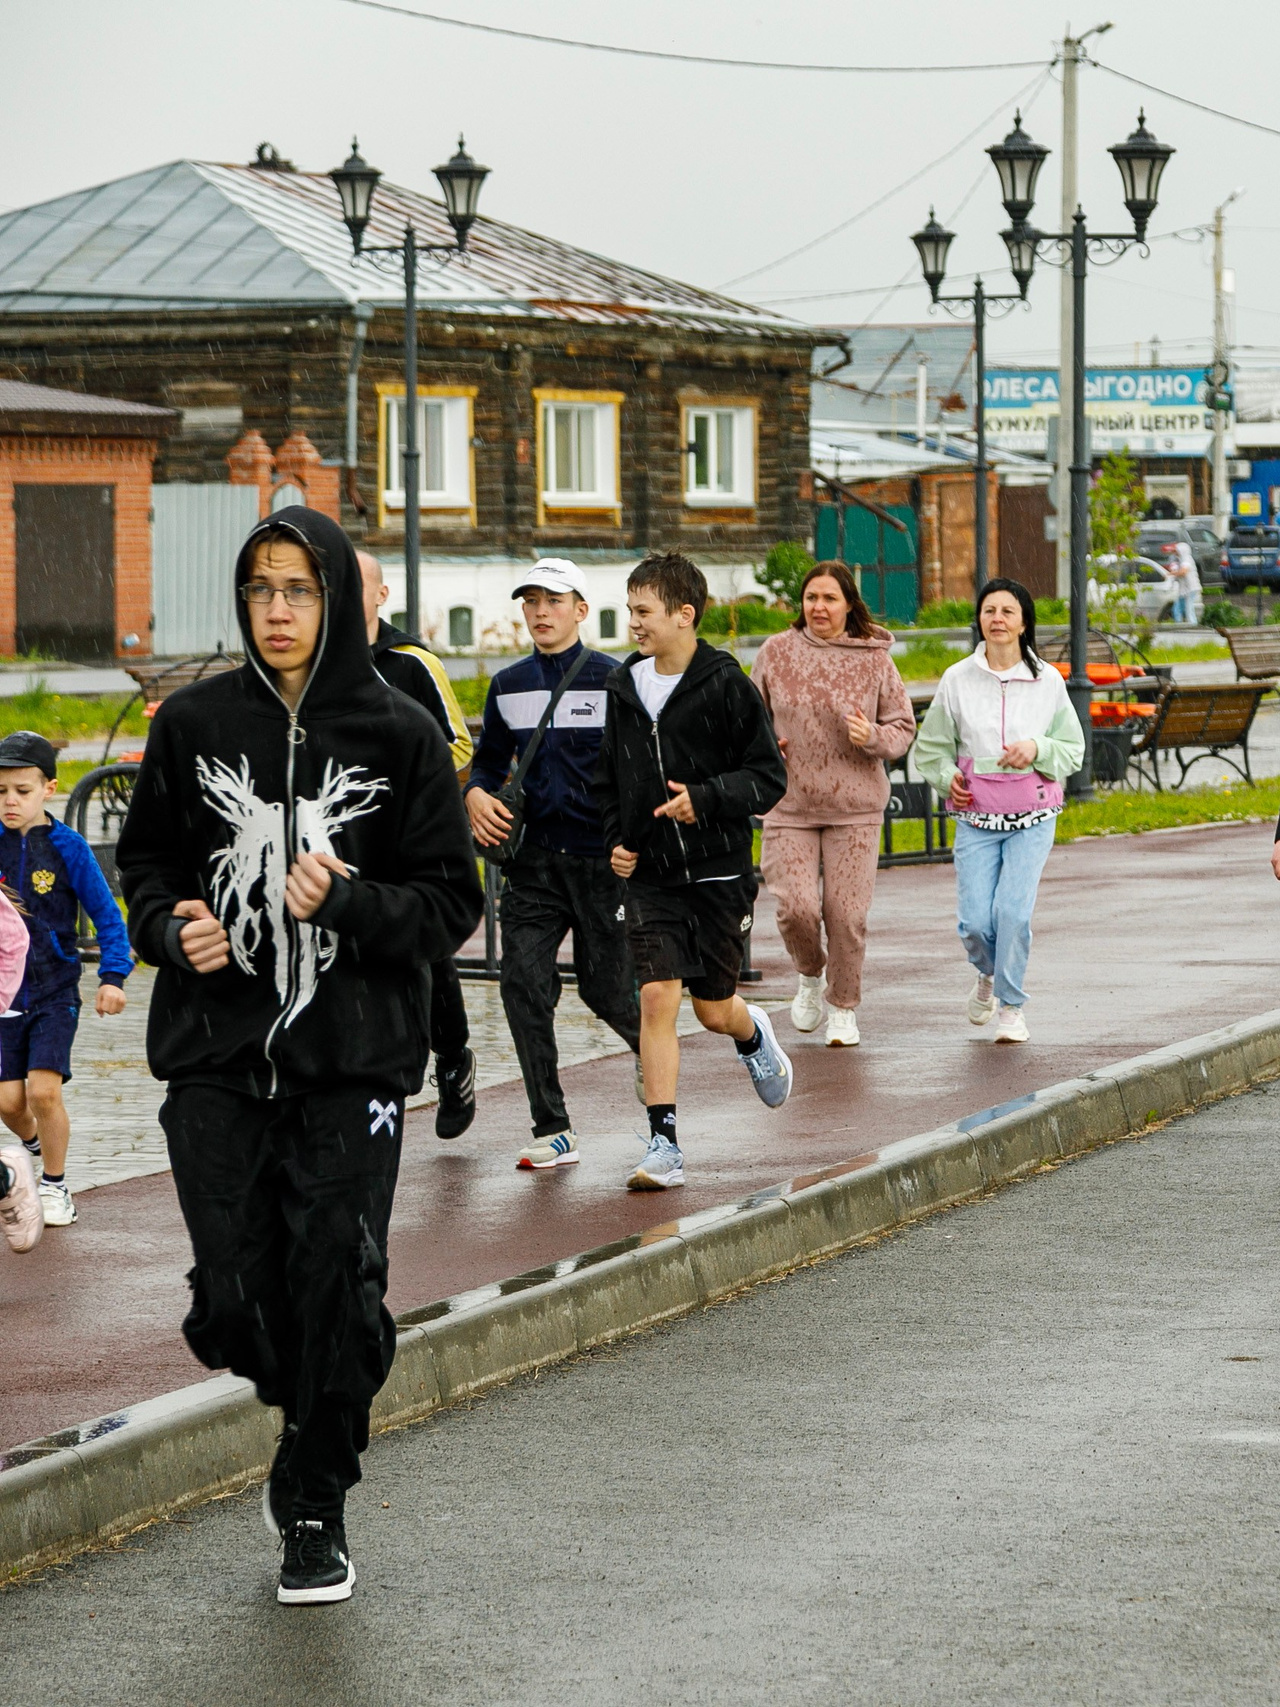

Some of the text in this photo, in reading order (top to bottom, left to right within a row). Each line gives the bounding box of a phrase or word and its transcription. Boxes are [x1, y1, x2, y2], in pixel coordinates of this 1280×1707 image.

[984, 374, 1193, 400] ЛЕСА ЫГОДНО
[1141, 414, 1200, 432] ЦЕНТР
[571, 708, 592, 716] PUMA
